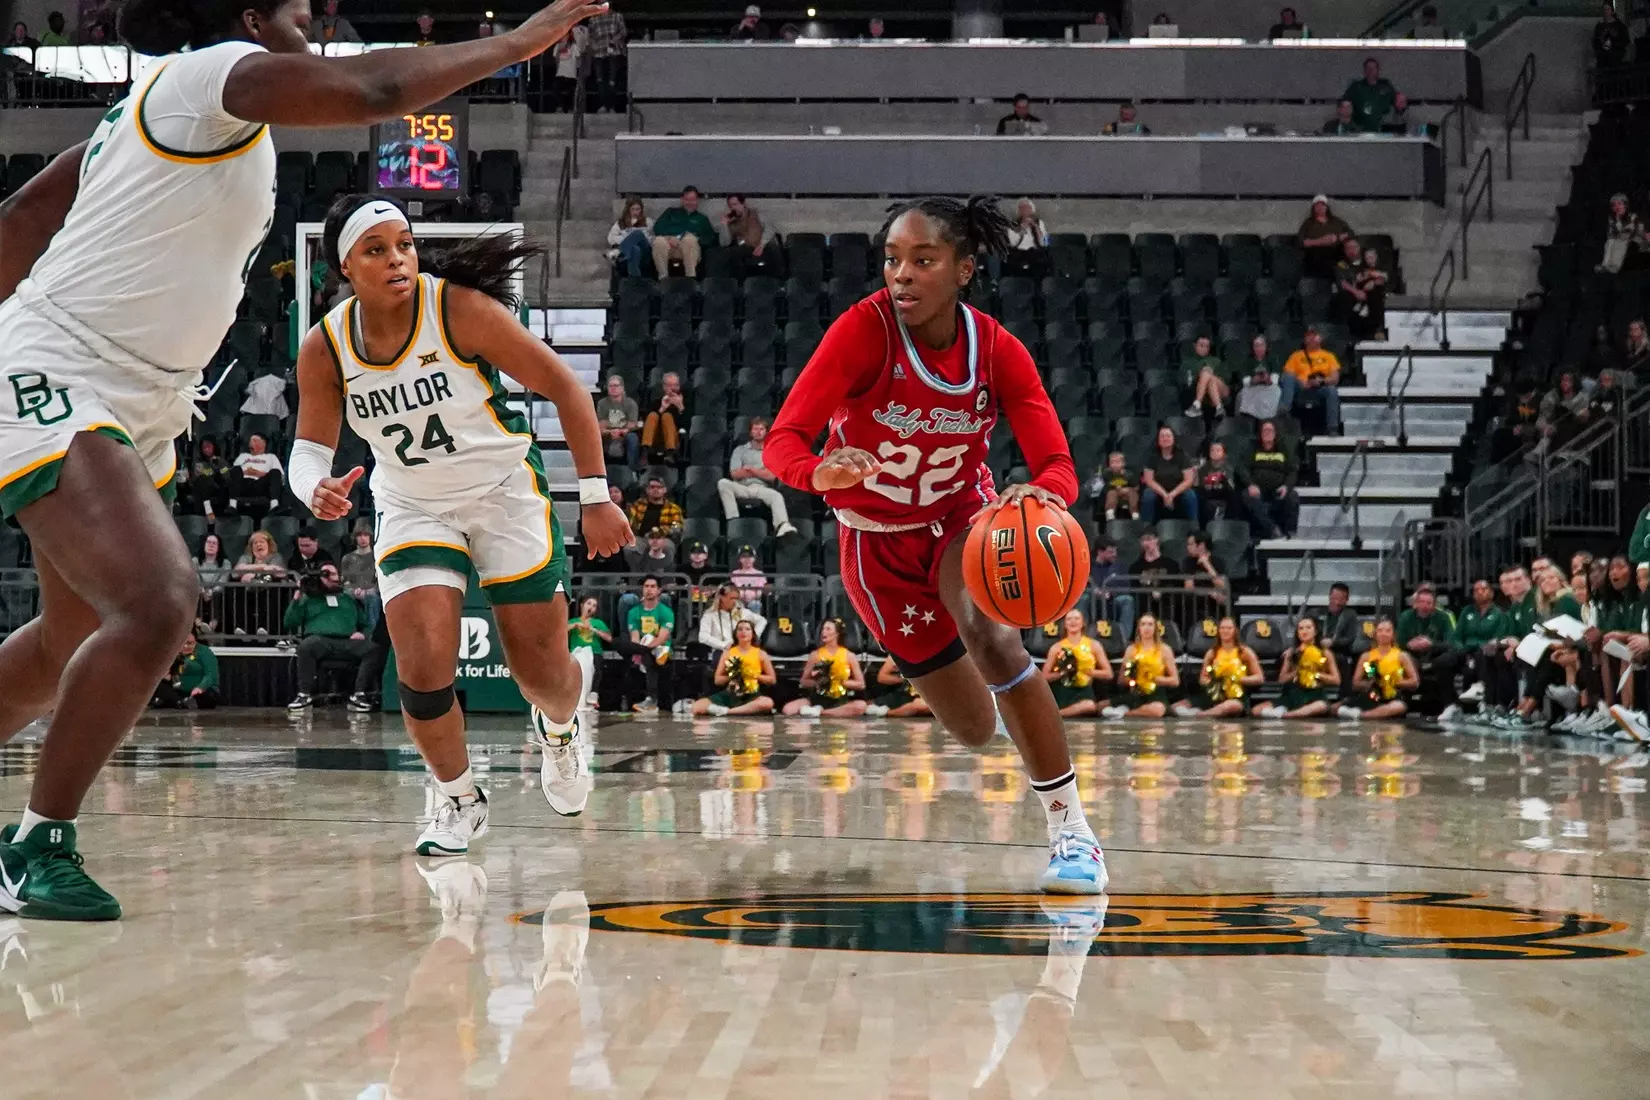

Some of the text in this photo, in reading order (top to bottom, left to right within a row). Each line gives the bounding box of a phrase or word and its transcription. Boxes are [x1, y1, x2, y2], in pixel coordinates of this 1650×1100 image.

[403, 114, 453, 141] 7:55
[409, 143, 446, 190] 12
[8, 372, 73, 425] BU
[350, 371, 453, 419] BAYLOR
[872, 400, 922, 438] Lady
[381, 413, 457, 467] 24
[863, 440, 969, 507] 22
[998, 528, 1022, 600] ELITE
[465, 664, 485, 677] for
[486, 664, 511, 678] Life
